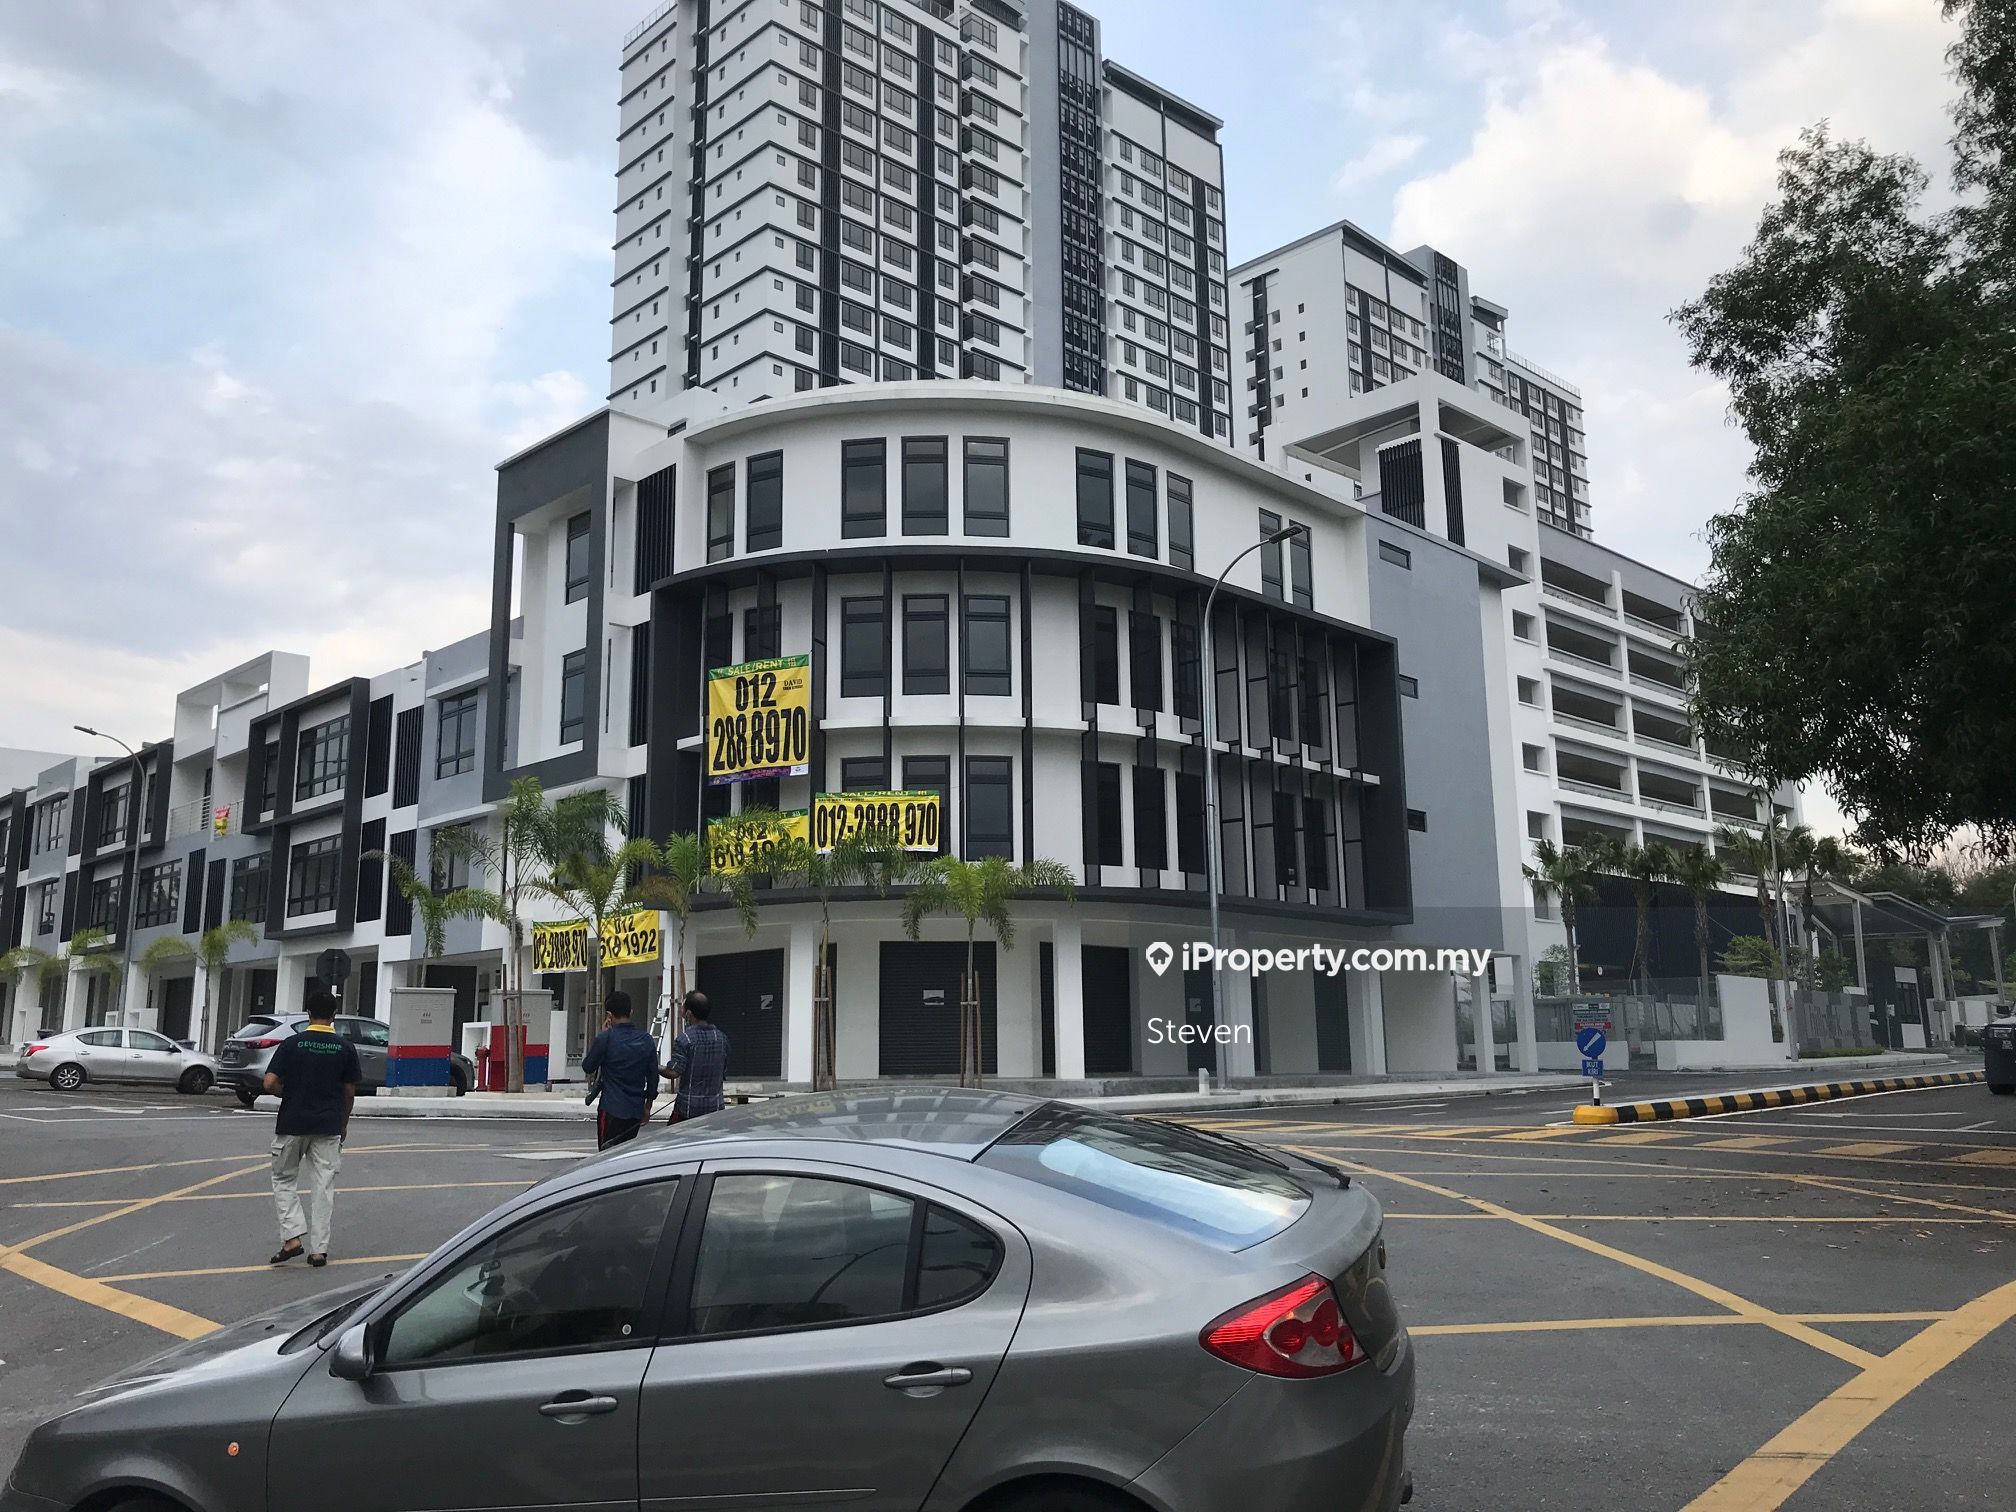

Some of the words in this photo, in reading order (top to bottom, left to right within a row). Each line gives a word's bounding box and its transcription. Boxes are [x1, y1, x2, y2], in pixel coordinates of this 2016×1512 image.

[727, 660, 783, 676] SALE/RENT
[736, 672, 777, 711] 012
[614, 915, 635, 934] 012
